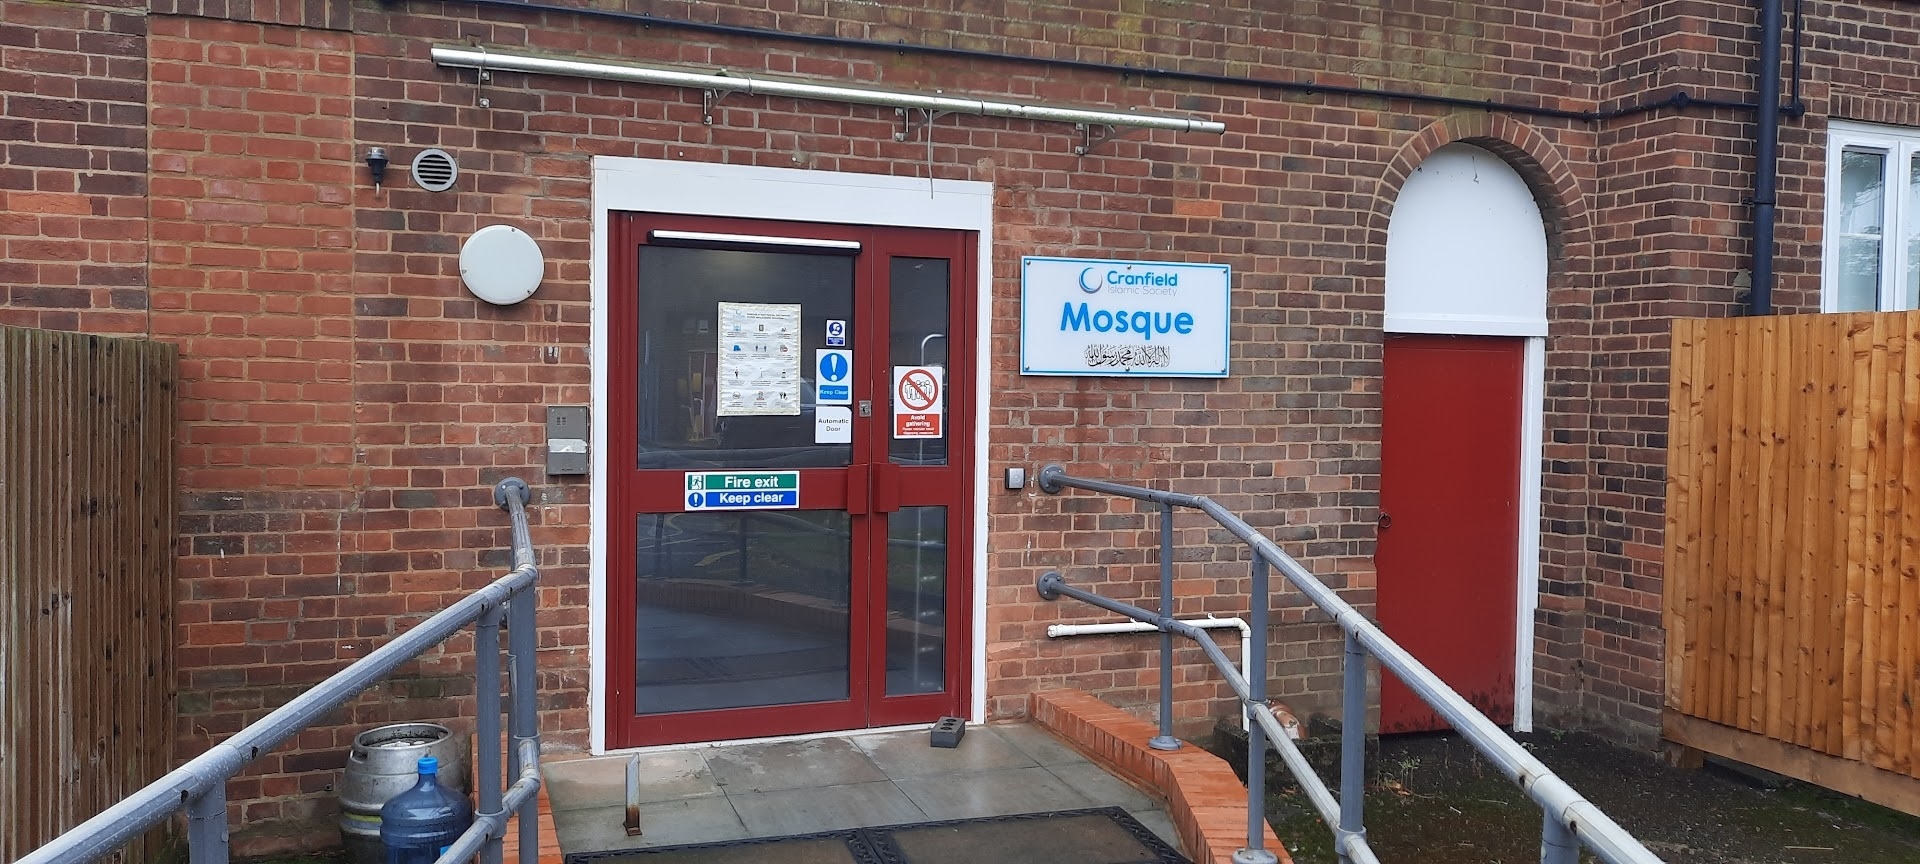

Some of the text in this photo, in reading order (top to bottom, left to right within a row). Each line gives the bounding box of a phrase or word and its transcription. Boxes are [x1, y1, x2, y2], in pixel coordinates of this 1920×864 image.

[1107, 270, 1178, 287] Cranfield
[1107, 285, 1178, 296] Islamic Society
[1060, 302, 1194, 340] Mosque
[724, 476, 779, 488] Fire exit
[720, 492, 784, 505] Keep clear
